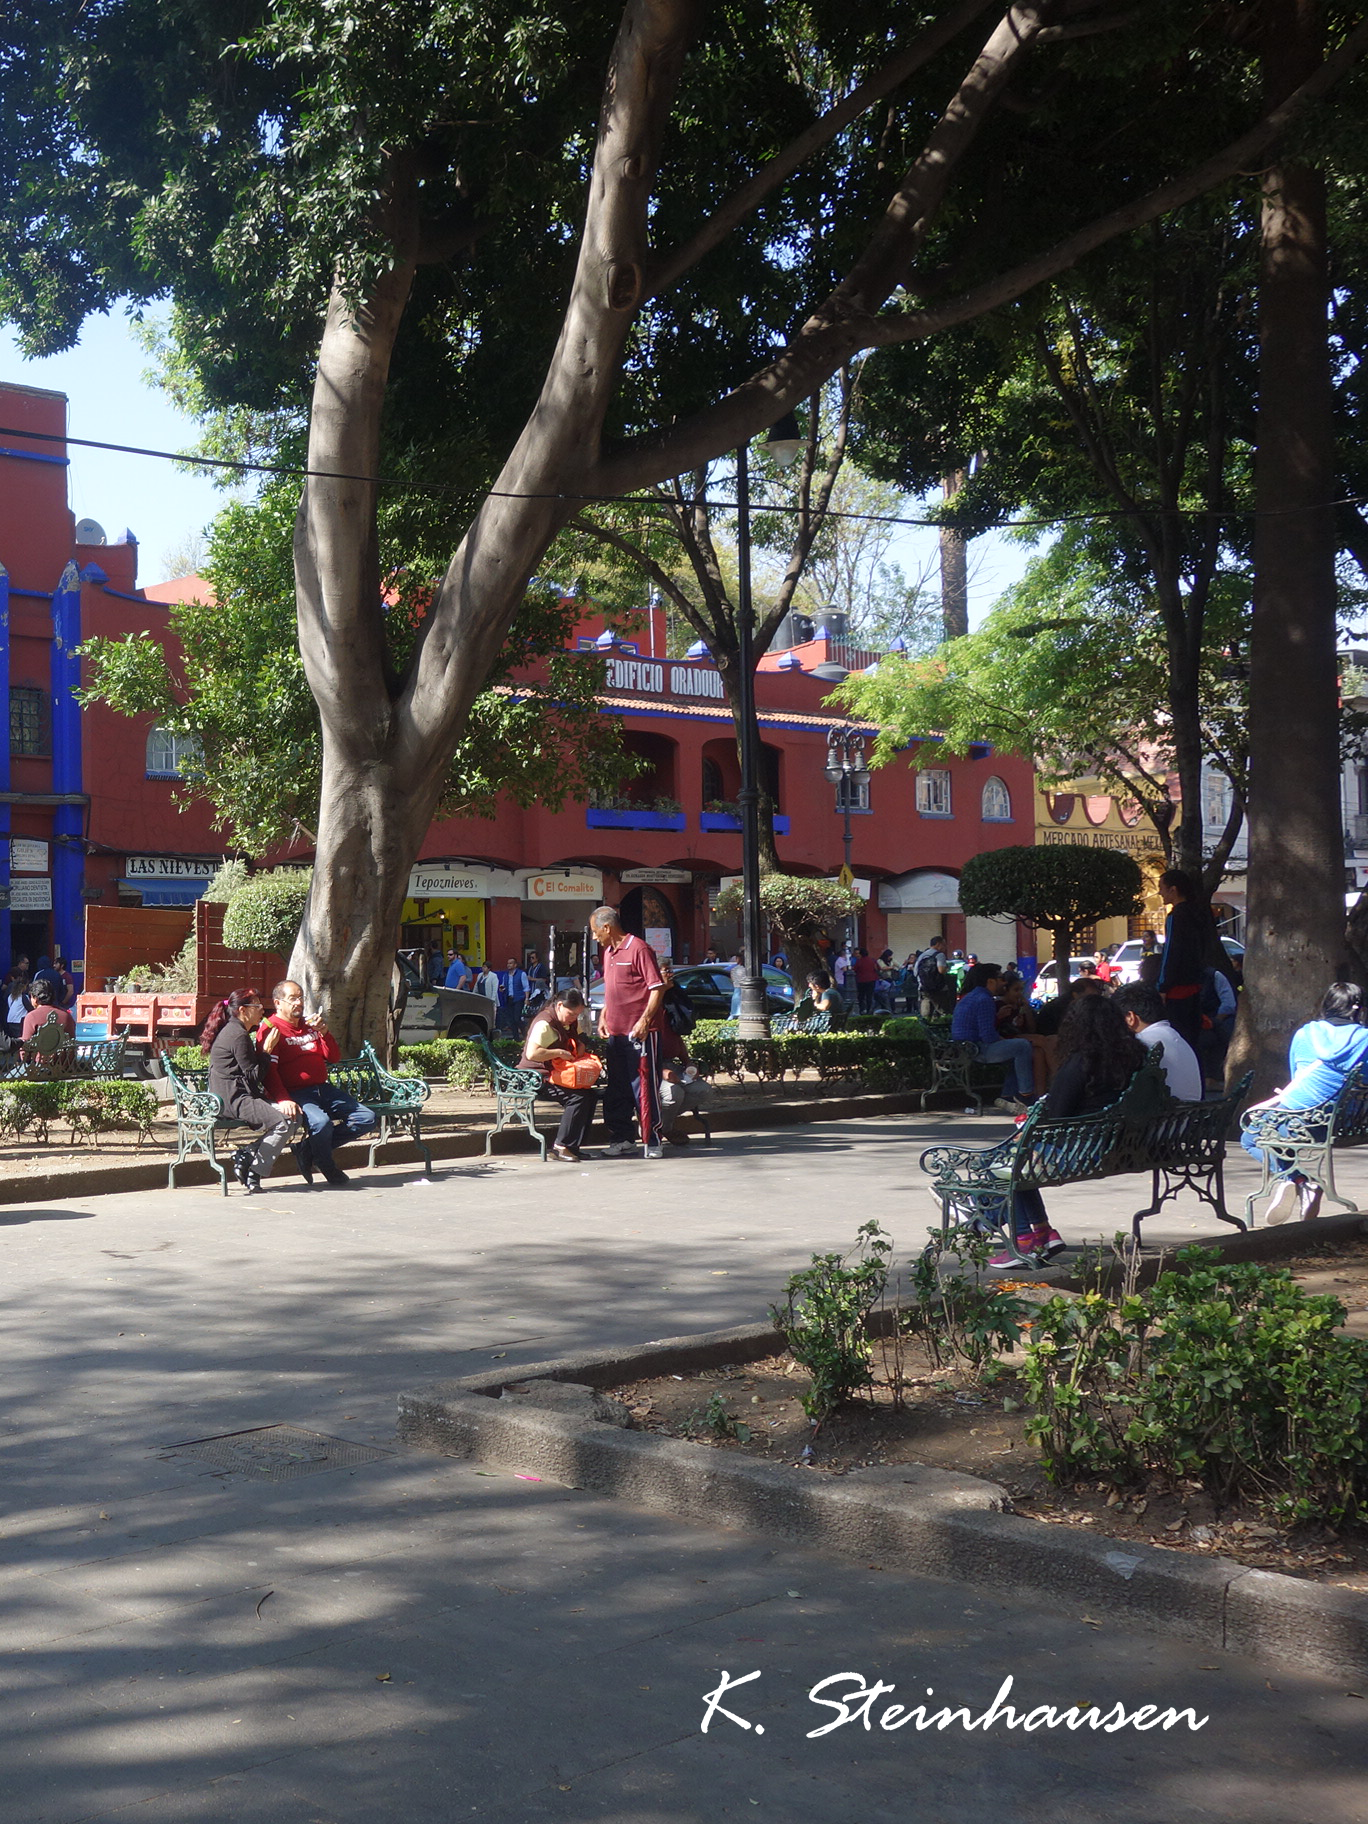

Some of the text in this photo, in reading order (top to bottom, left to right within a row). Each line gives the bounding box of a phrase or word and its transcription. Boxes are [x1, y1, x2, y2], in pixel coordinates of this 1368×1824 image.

[670, 665, 724, 699] ORADOUR
[1043, 831, 1089, 846] MERCADO
[130, 859, 155, 874] LAS
[159, 859, 210, 875] NIEVES
[415, 875, 474, 890] Tepoznieves
[546, 881, 555, 892] El
[557, 882, 594, 892] Comalito
